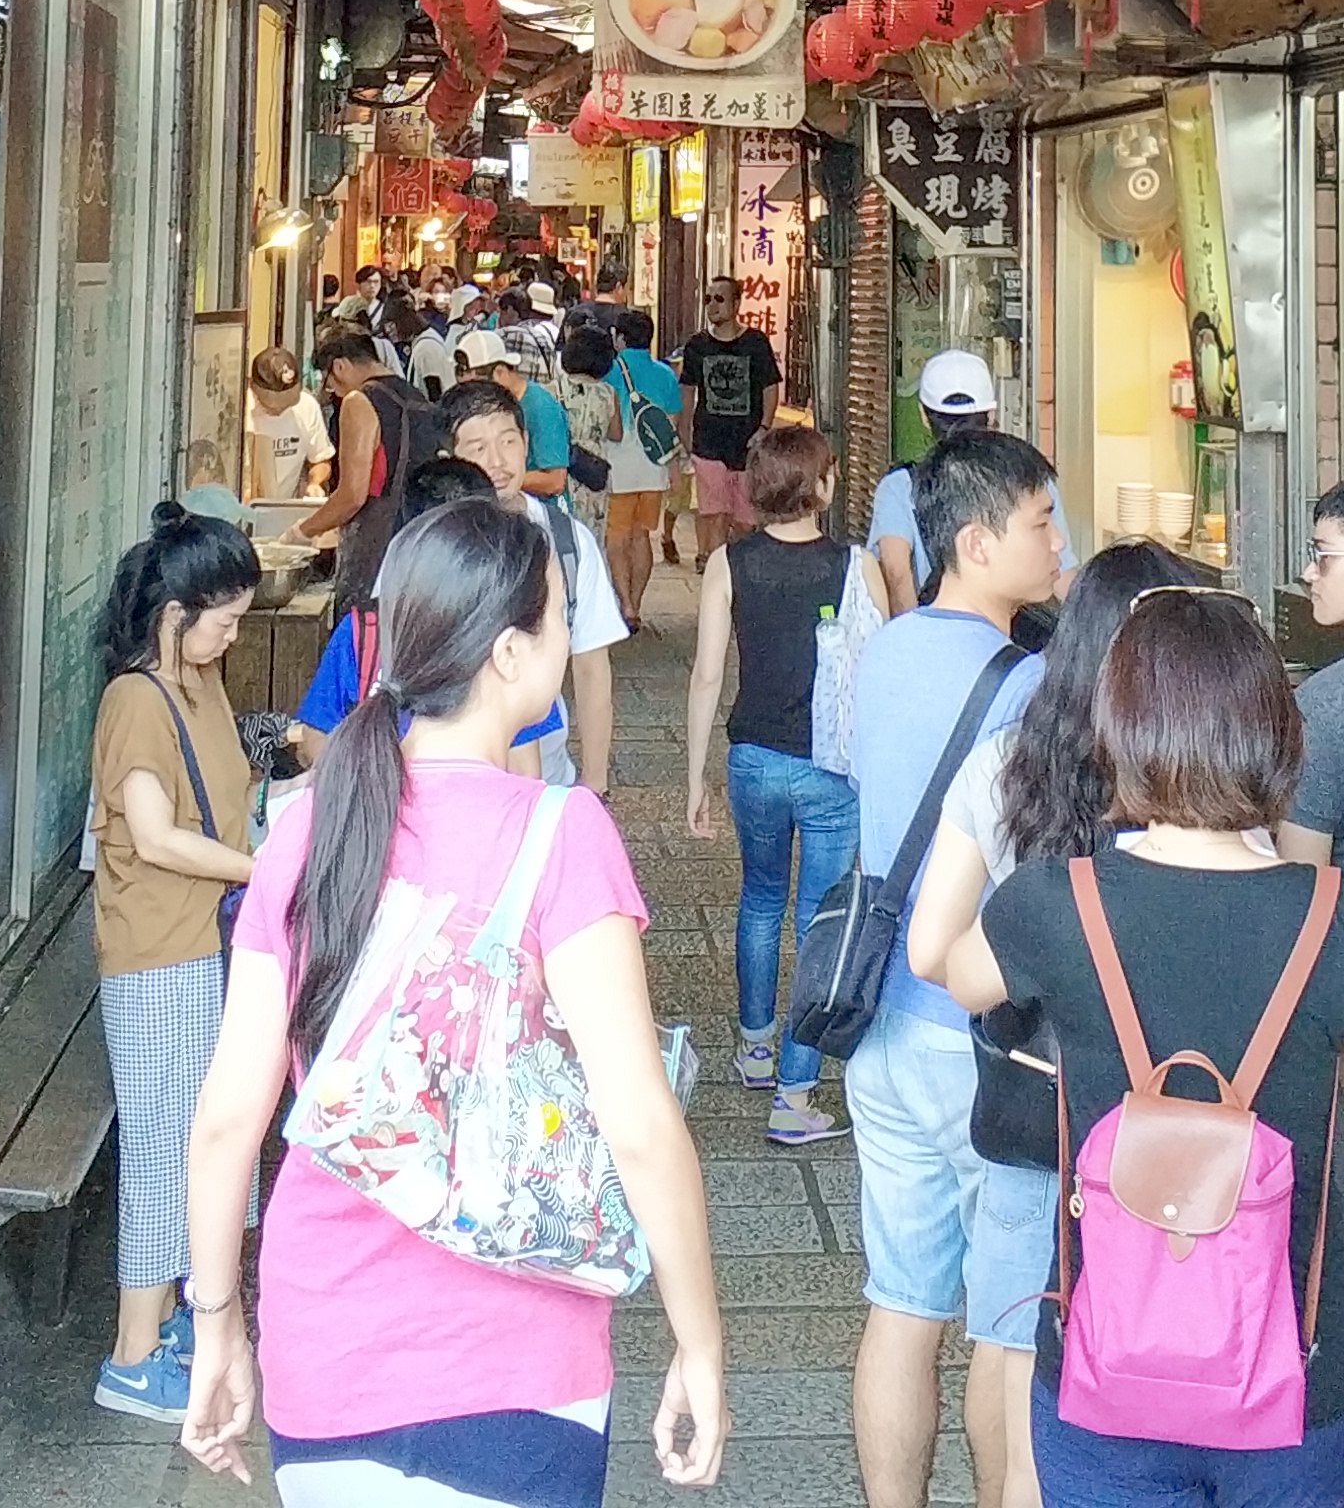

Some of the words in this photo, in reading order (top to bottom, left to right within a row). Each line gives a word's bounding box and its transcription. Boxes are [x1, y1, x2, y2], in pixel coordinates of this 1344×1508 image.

[884, 116, 1011, 166] 臭豆腐
[923, 173, 1013, 220] 現烤
